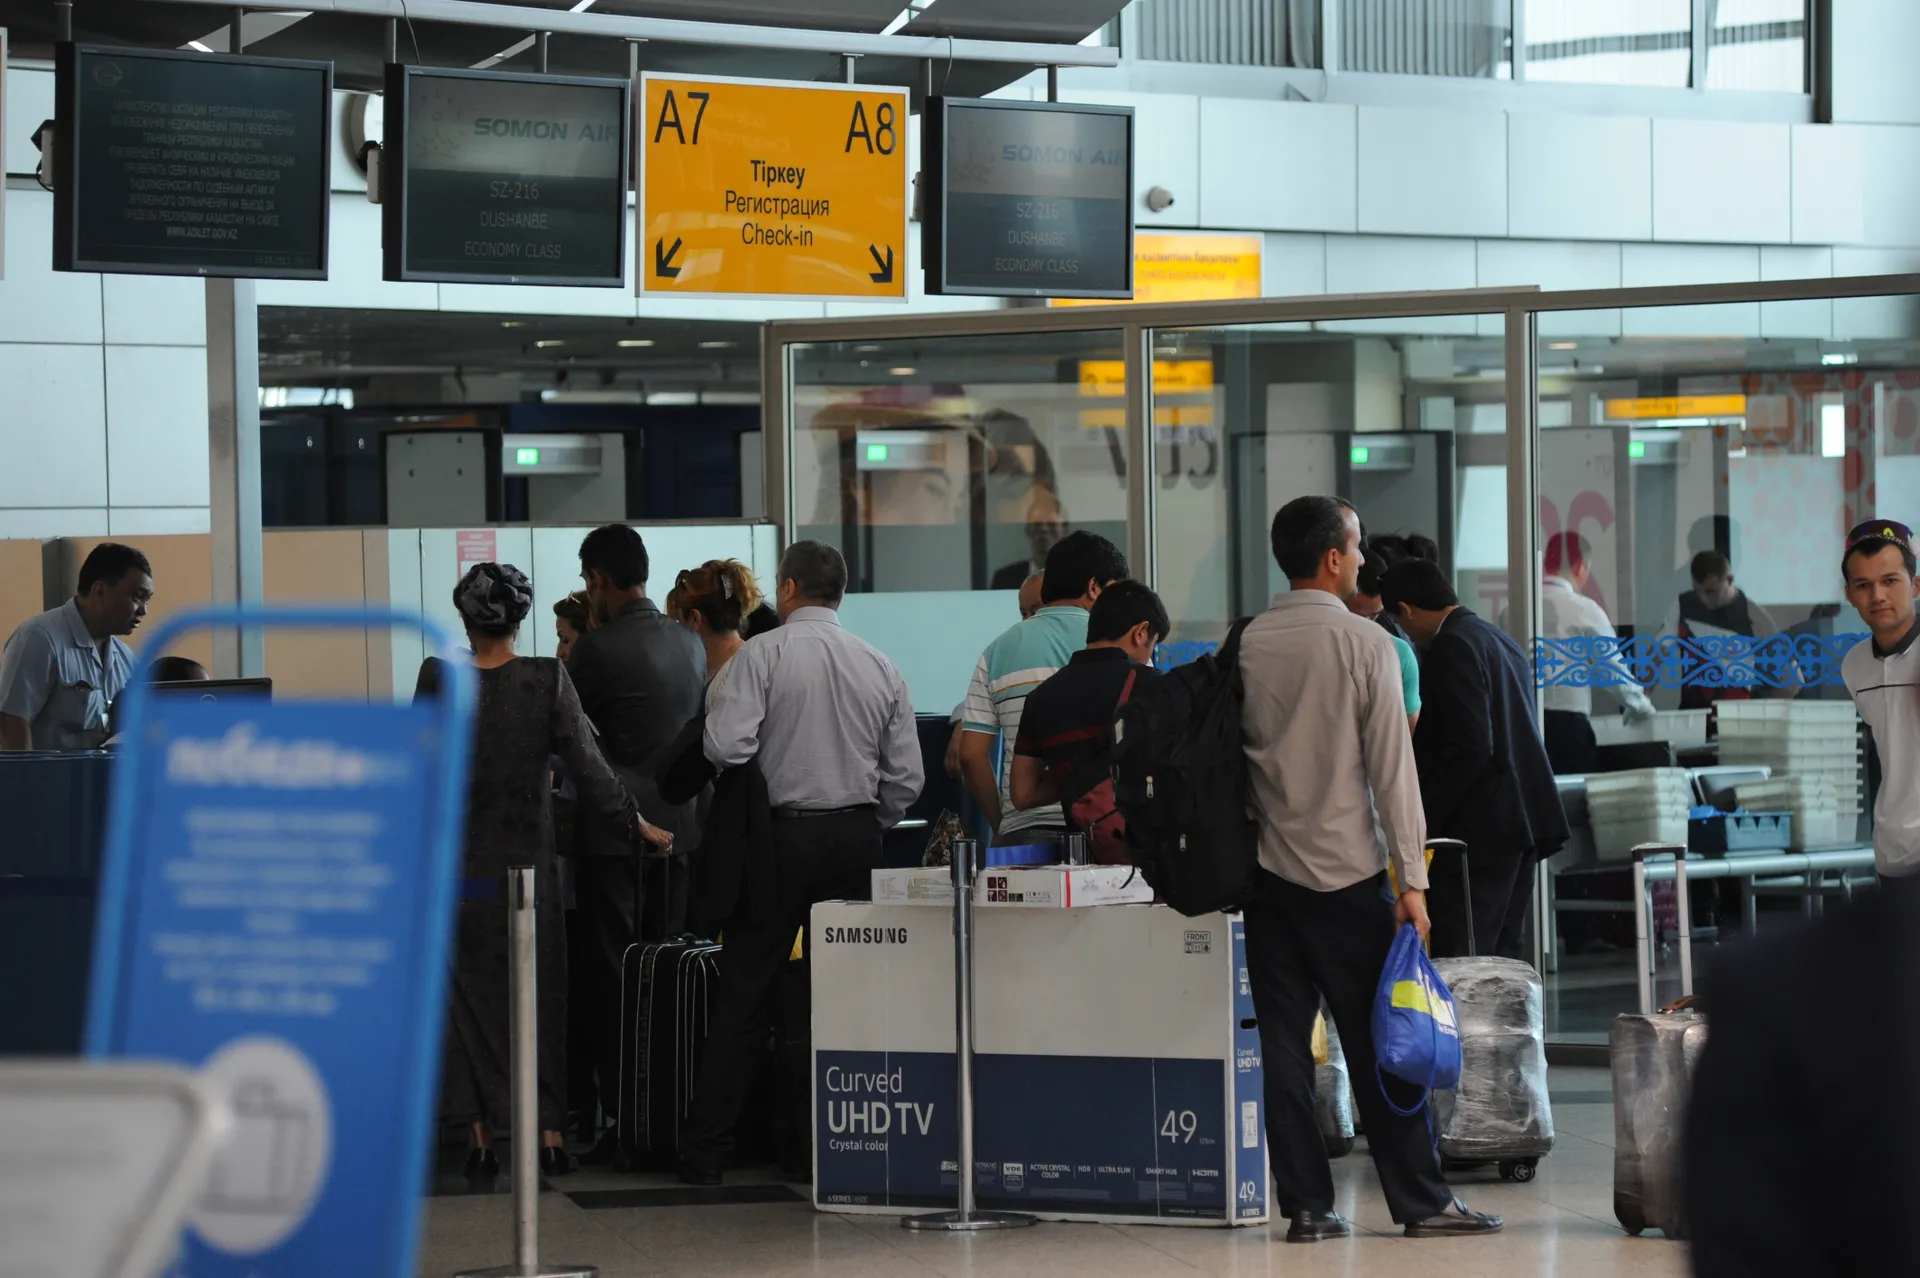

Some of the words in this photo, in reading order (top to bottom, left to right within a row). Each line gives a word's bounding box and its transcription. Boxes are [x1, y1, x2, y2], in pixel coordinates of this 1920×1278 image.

[653, 89, 710, 146] A7
[474, 117, 568, 140] SOMON
[844, 100, 897, 156] A8
[1002, 144, 1082, 164] SOMON
[750, 159, 806, 190] Тіркеу
[489, 181, 540, 199] SZ-216
[724, 191, 830, 221] Регистрация
[1016, 203, 1059, 219] SZ-216
[480, 211, 548, 229] DUSHANBE
[742, 223, 814, 248] Check-in
[1008, 230, 1067, 246] DUSHANBE
[464, 240, 522, 257] ECONOMY
[525, 243, 562, 259] CLASS
[995, 257, 1045, 273] ECONOMY
[1047, 259, 1079, 274] CLASS
[824, 927, 907, 944] SAMSUNG
[1186, 933, 1208, 941] FRONT
[826, 1065, 903, 1094] Curved
[1160, 1110, 1197, 1144] 49
[829, 1139, 863, 1152] Crystal
[1029, 1163, 1048, 1171] ACTIVE
[1049, 1164, 1071, 1172] CRYSTAL
[1041, 1171, 1060, 1179] COLOR
[1098, 1165, 1116, 1173] ULTRA
[1117, 1166, 1131, 1174] SLIM
[832, 1195, 852, 1203] SERIES
[1239, 1181, 1256, 1203] 49
[1246, 1209, 1260, 1217] SERIES
